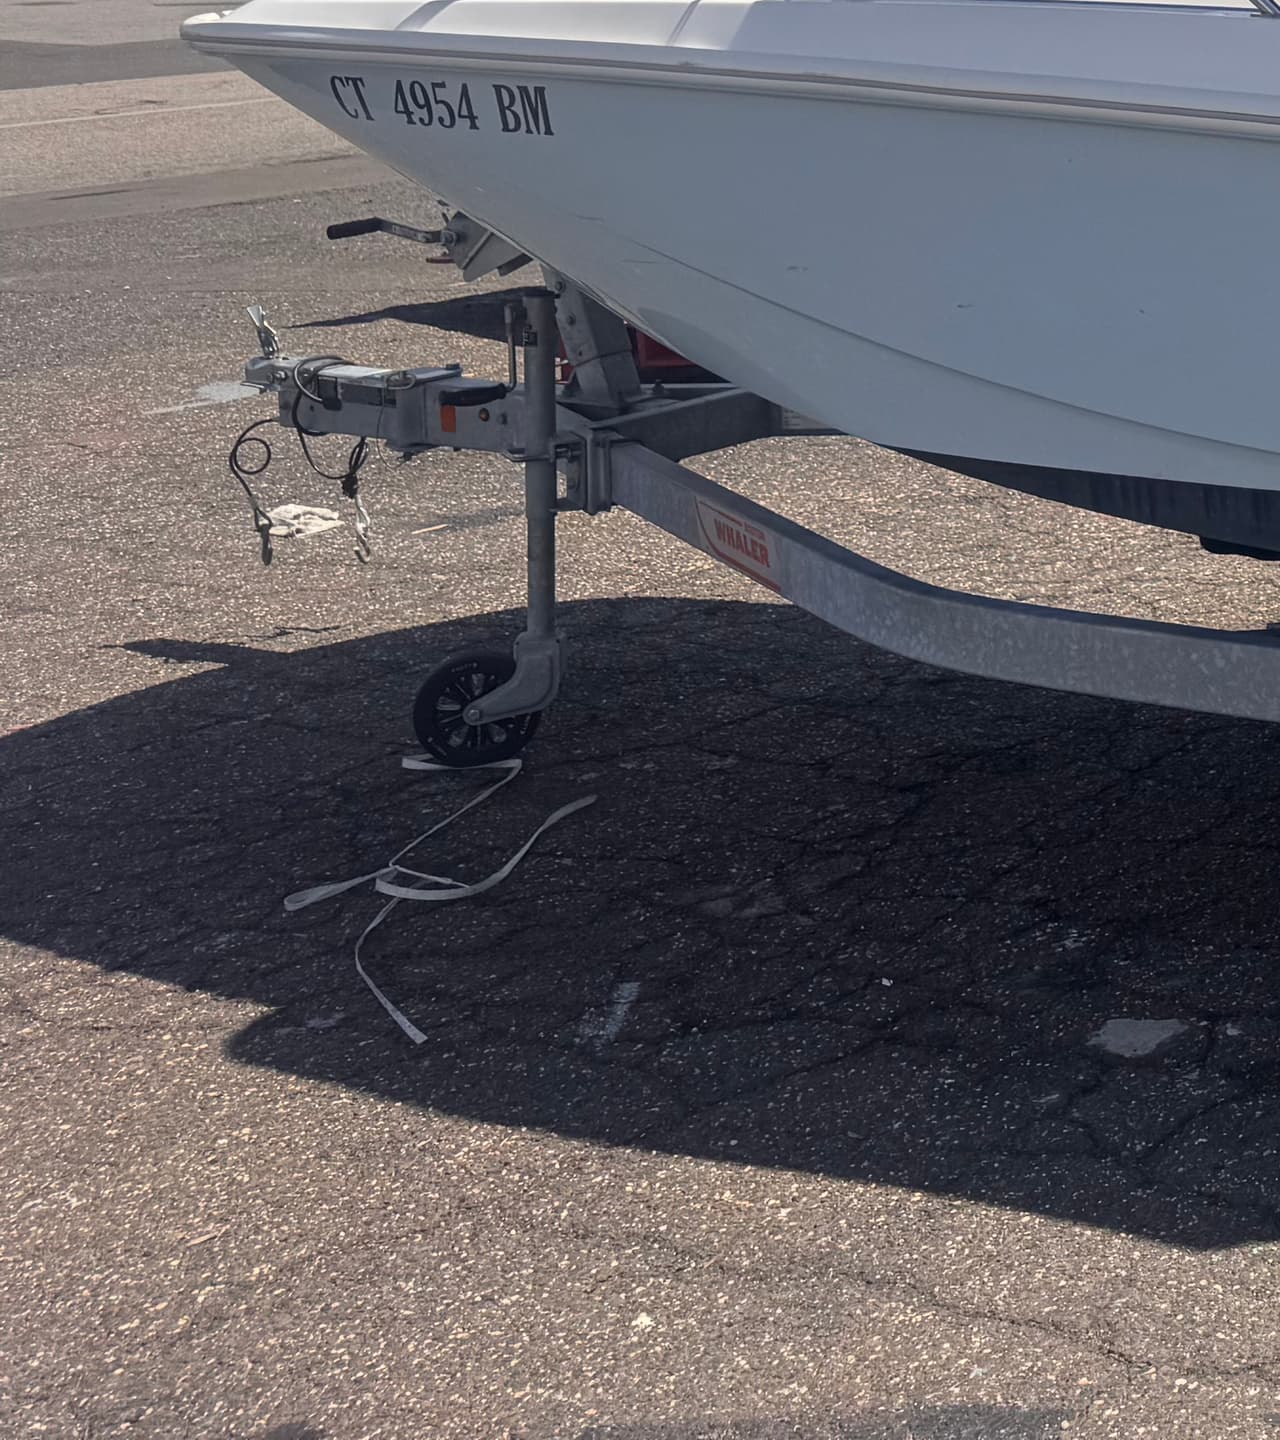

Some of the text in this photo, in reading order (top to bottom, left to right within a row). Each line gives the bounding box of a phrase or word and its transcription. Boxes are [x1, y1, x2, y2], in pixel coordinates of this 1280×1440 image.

[330, 75, 555, 136] CT 4954 BM
[714, 518, 770, 568] WHALER
